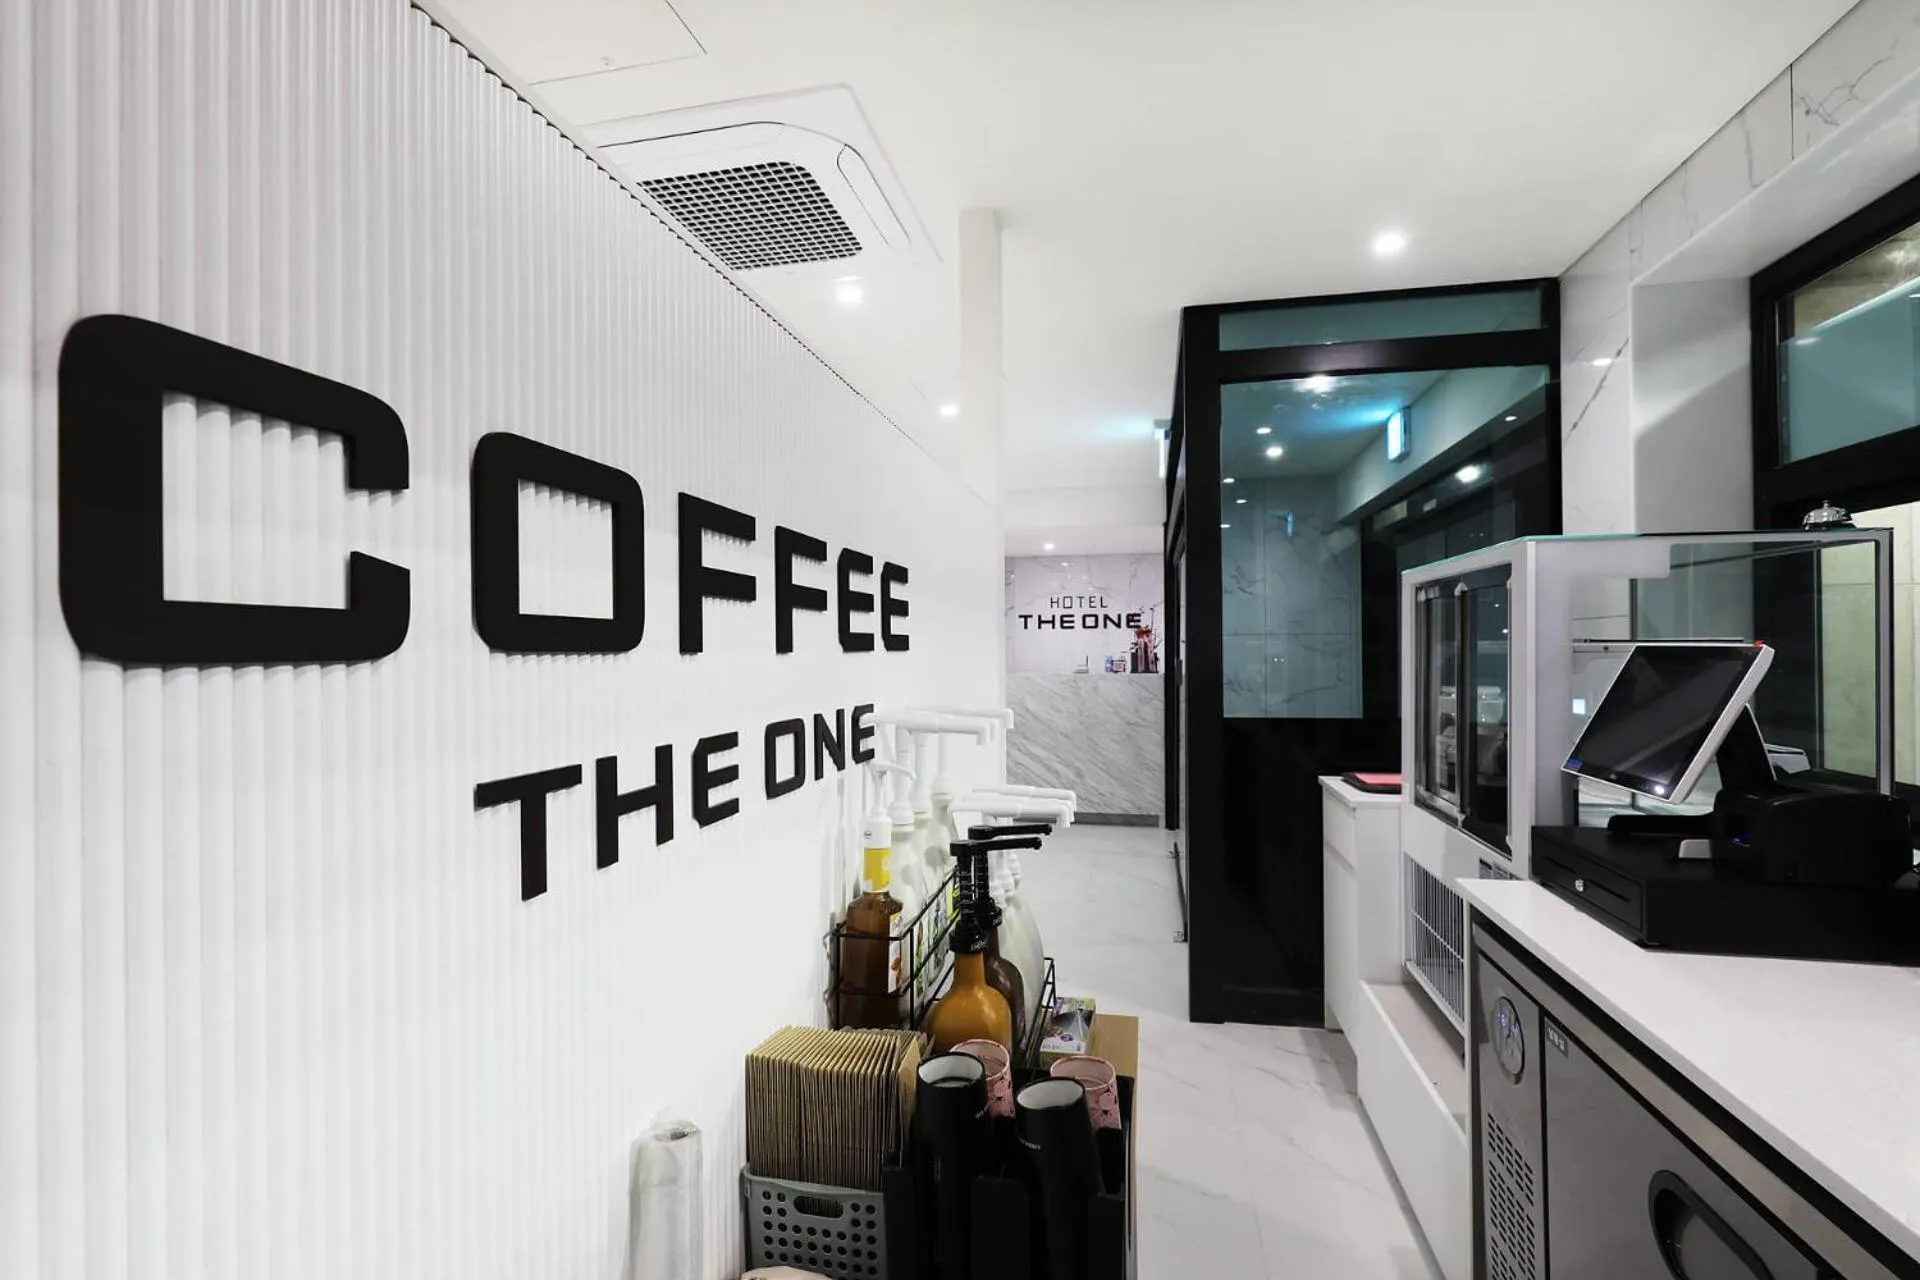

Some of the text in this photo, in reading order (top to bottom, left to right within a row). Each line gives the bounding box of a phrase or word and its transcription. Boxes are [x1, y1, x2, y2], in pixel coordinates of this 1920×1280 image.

[59, 314, 911, 667] COFFEE
[1050, 596, 1109, 609] HOTEL
[474, 704, 875, 902] THE ONE
